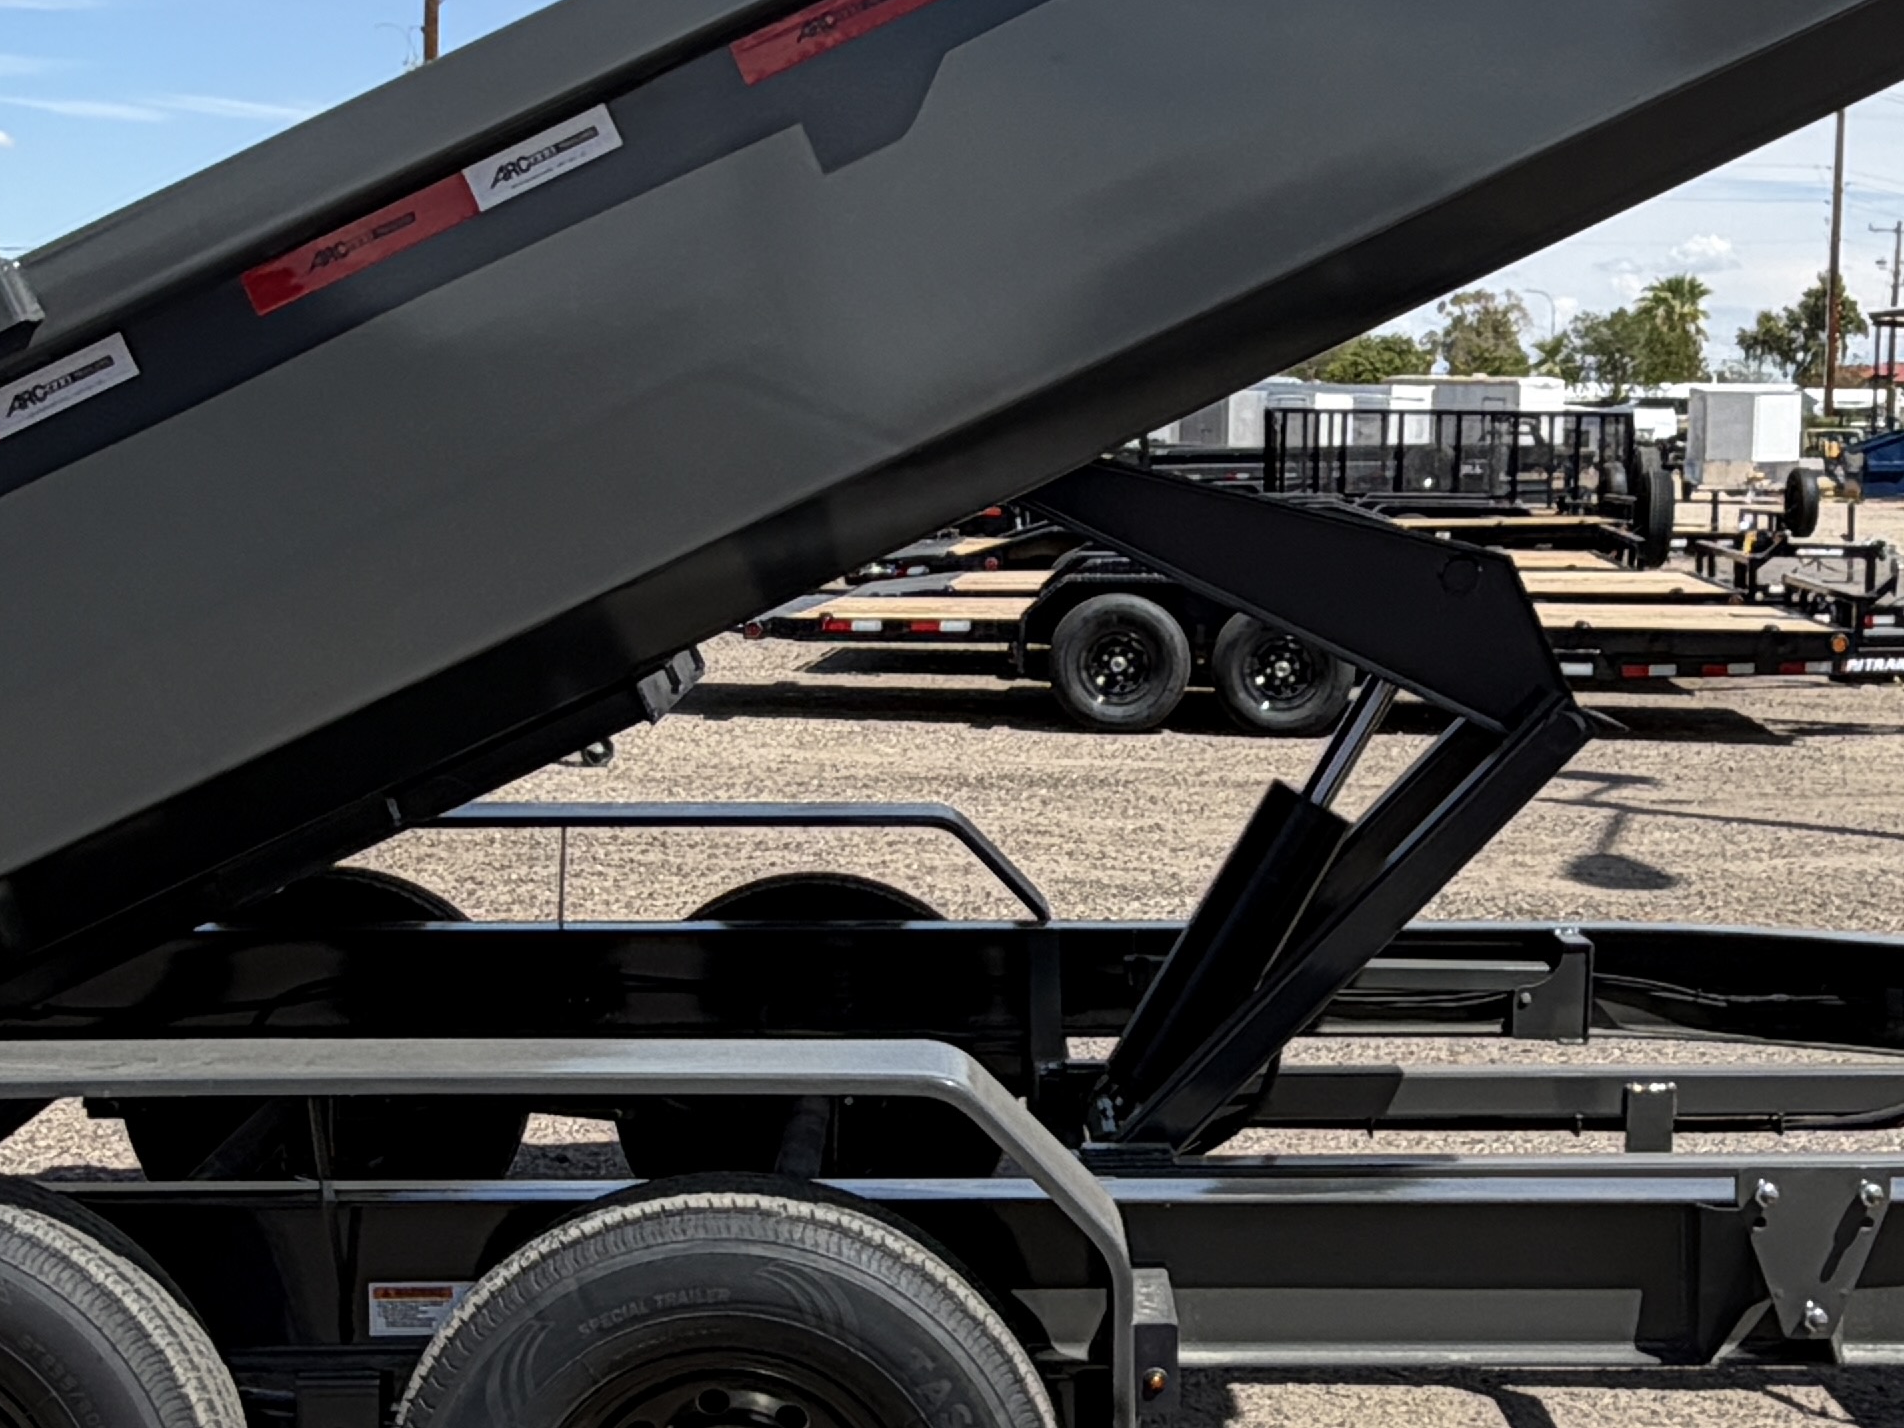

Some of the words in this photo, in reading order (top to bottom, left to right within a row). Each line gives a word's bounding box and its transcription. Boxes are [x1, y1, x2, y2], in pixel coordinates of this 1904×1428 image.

[490, 156, 532, 189] ARC
[6, 384, 49, 418] ARC
[577, 1299, 651, 1335] SPECIAL
[653, 1288, 732, 1310] TRAILER
